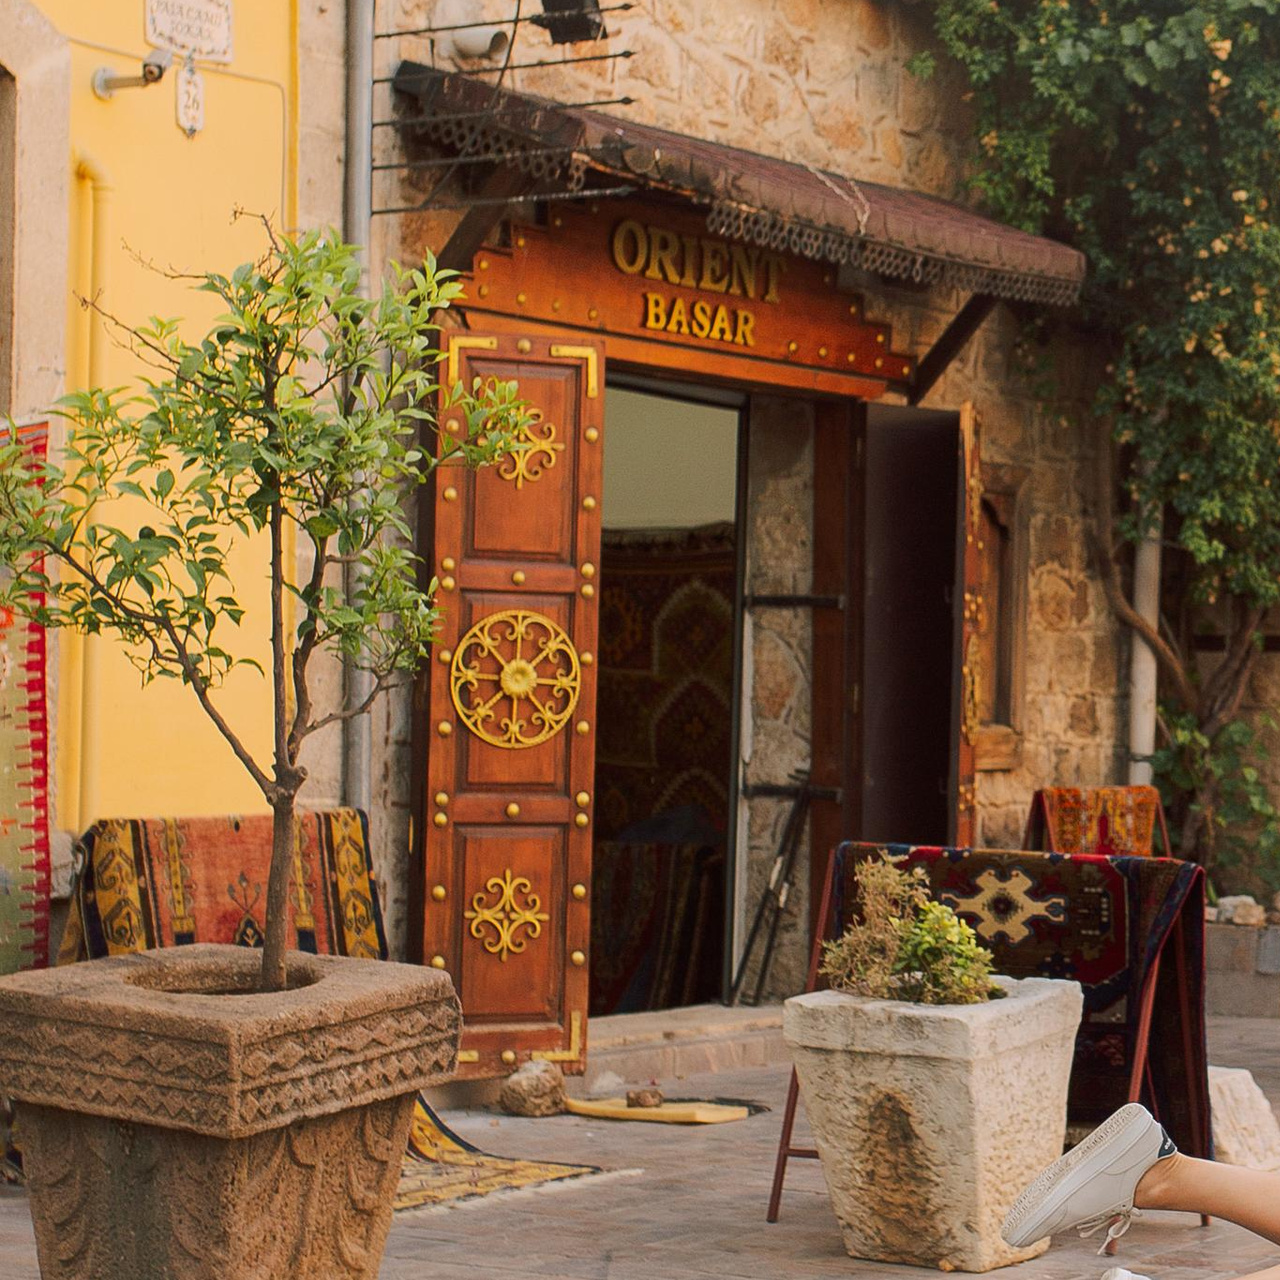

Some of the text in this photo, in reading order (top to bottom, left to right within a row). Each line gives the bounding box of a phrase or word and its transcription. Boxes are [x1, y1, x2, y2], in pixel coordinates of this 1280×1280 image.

[184, 89, 200, 111] 26
[612, 219, 788, 304] ORIENT
[643, 291, 756, 347] BASAR
